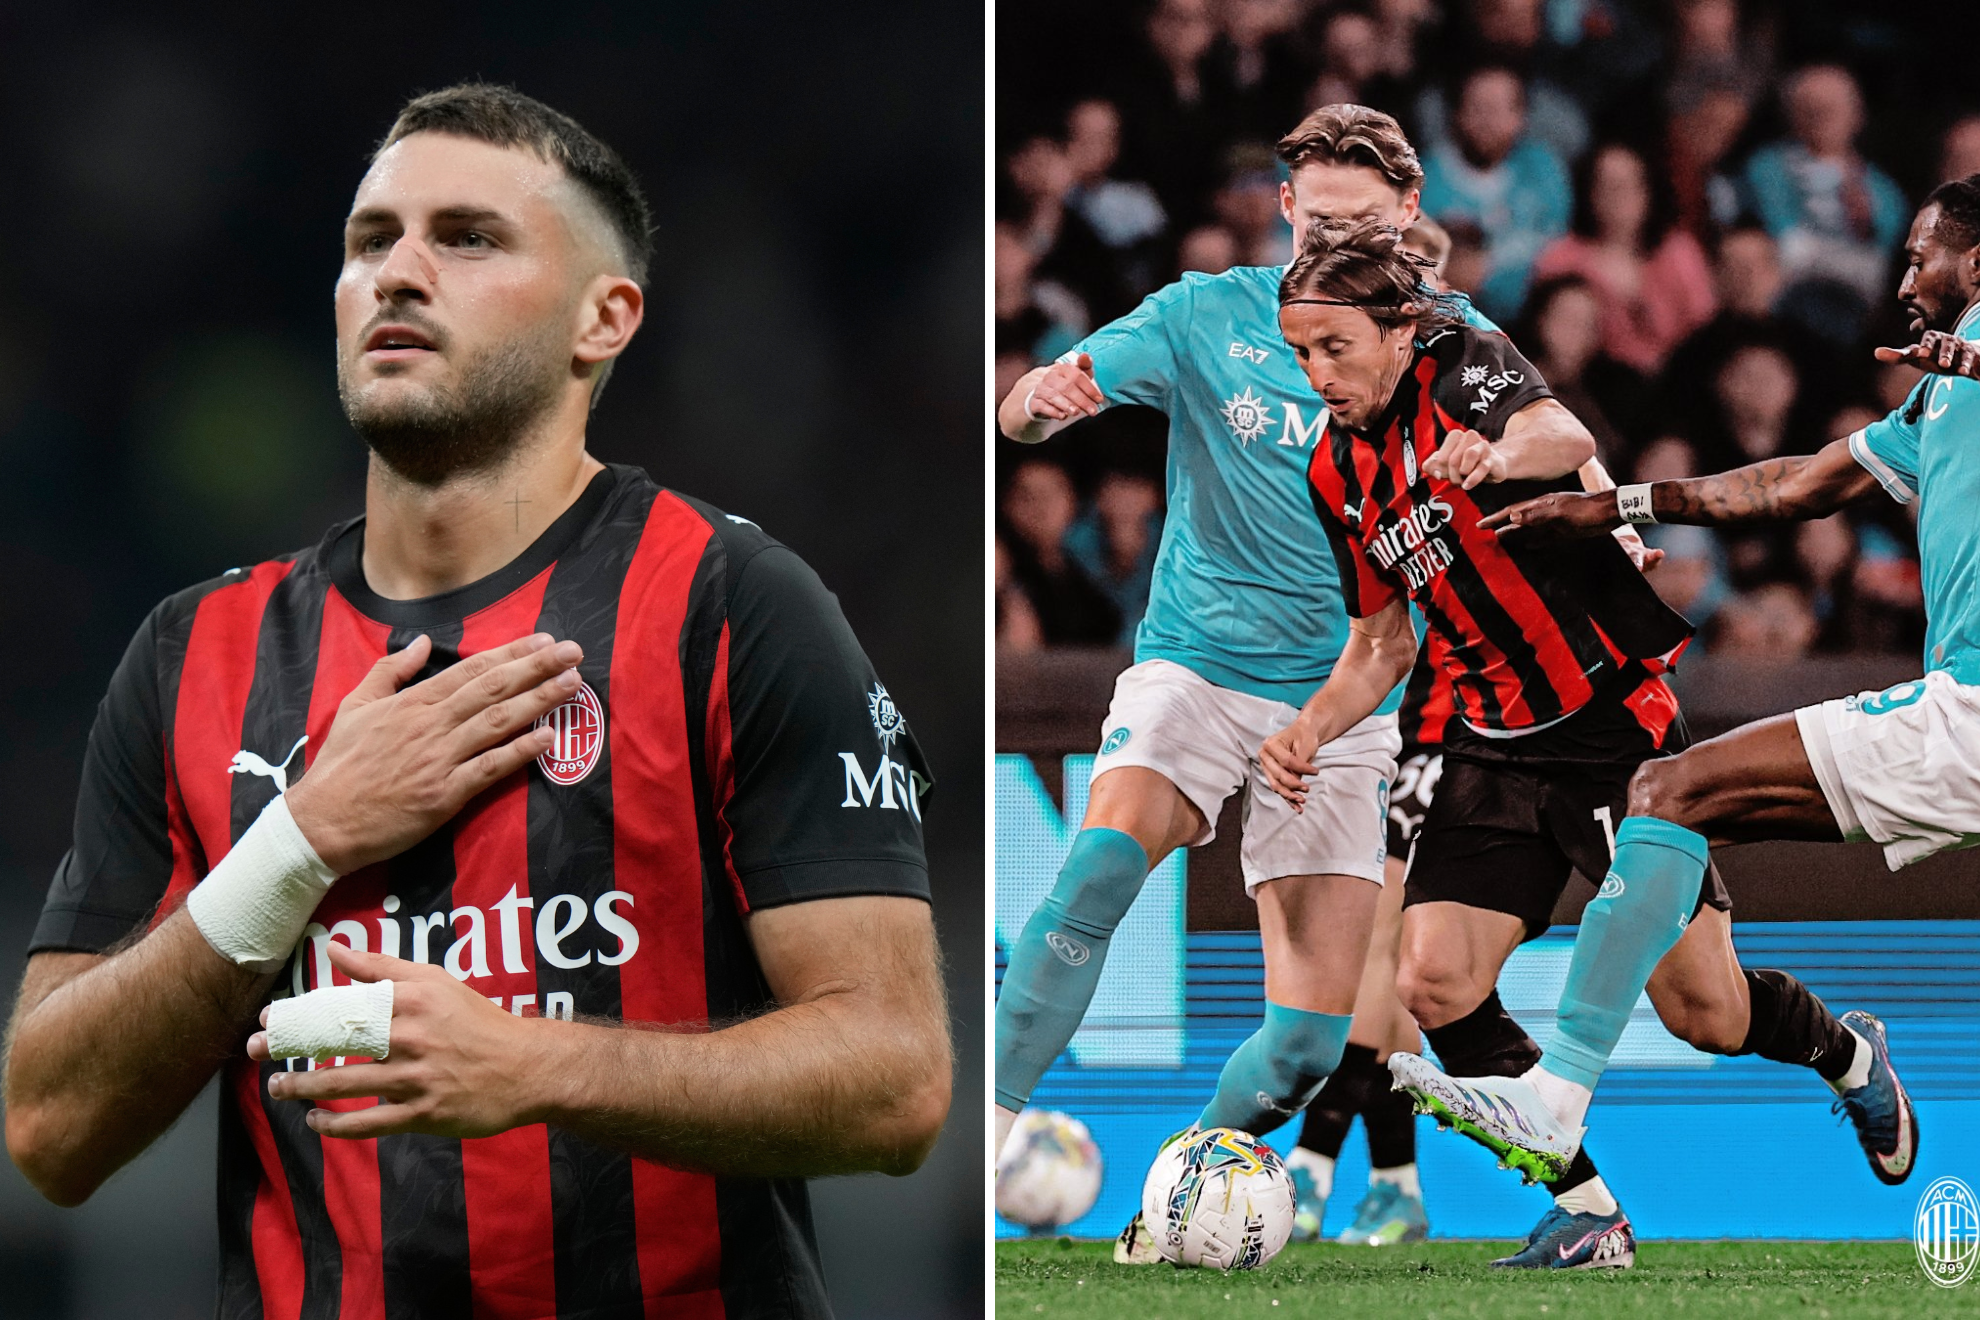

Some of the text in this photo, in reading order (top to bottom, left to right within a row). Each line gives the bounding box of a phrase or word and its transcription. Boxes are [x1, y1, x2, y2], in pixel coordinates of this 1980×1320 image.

[1228, 342, 1270, 365] EA7
[1469, 369, 1525, 415] MSC
[1365, 495, 1454, 570] mirates
[552, 759, 586, 774] 1899
[274, 882, 641, 998] mirates
